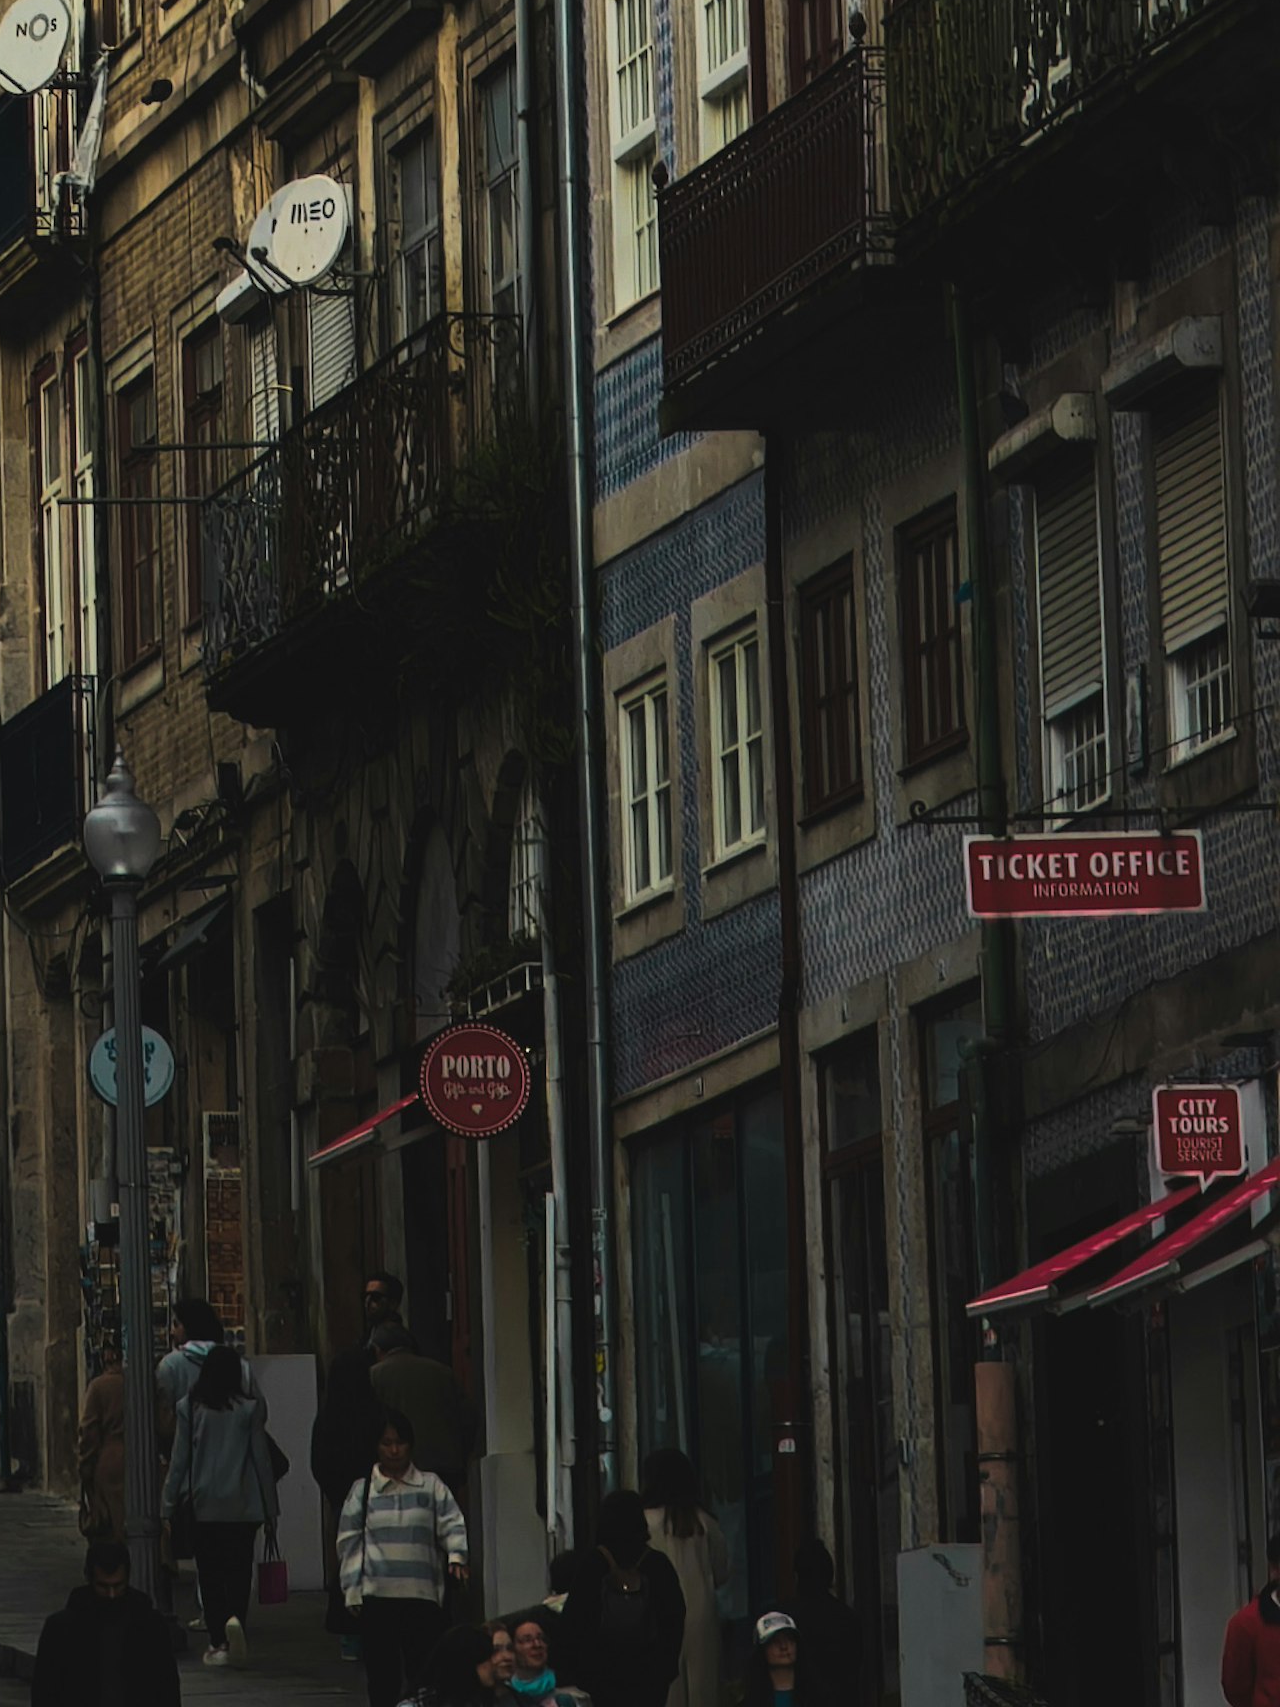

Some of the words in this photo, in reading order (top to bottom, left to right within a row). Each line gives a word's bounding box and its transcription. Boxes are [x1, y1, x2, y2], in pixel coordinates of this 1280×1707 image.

[16, 13, 57, 41] NOS
[978, 852, 1079, 880] TICKET
[1090, 850, 1190, 877] OFFICE
[1033, 882, 1140, 898] INFORMATION
[441, 1055, 511, 1078] PORTO
[1178, 1098, 1217, 1115] CITY
[1168, 1117, 1230, 1134] TOURS
[1177, 1137, 1223, 1149] TOURIST
[1177, 1149, 1223, 1162] SERVICE
